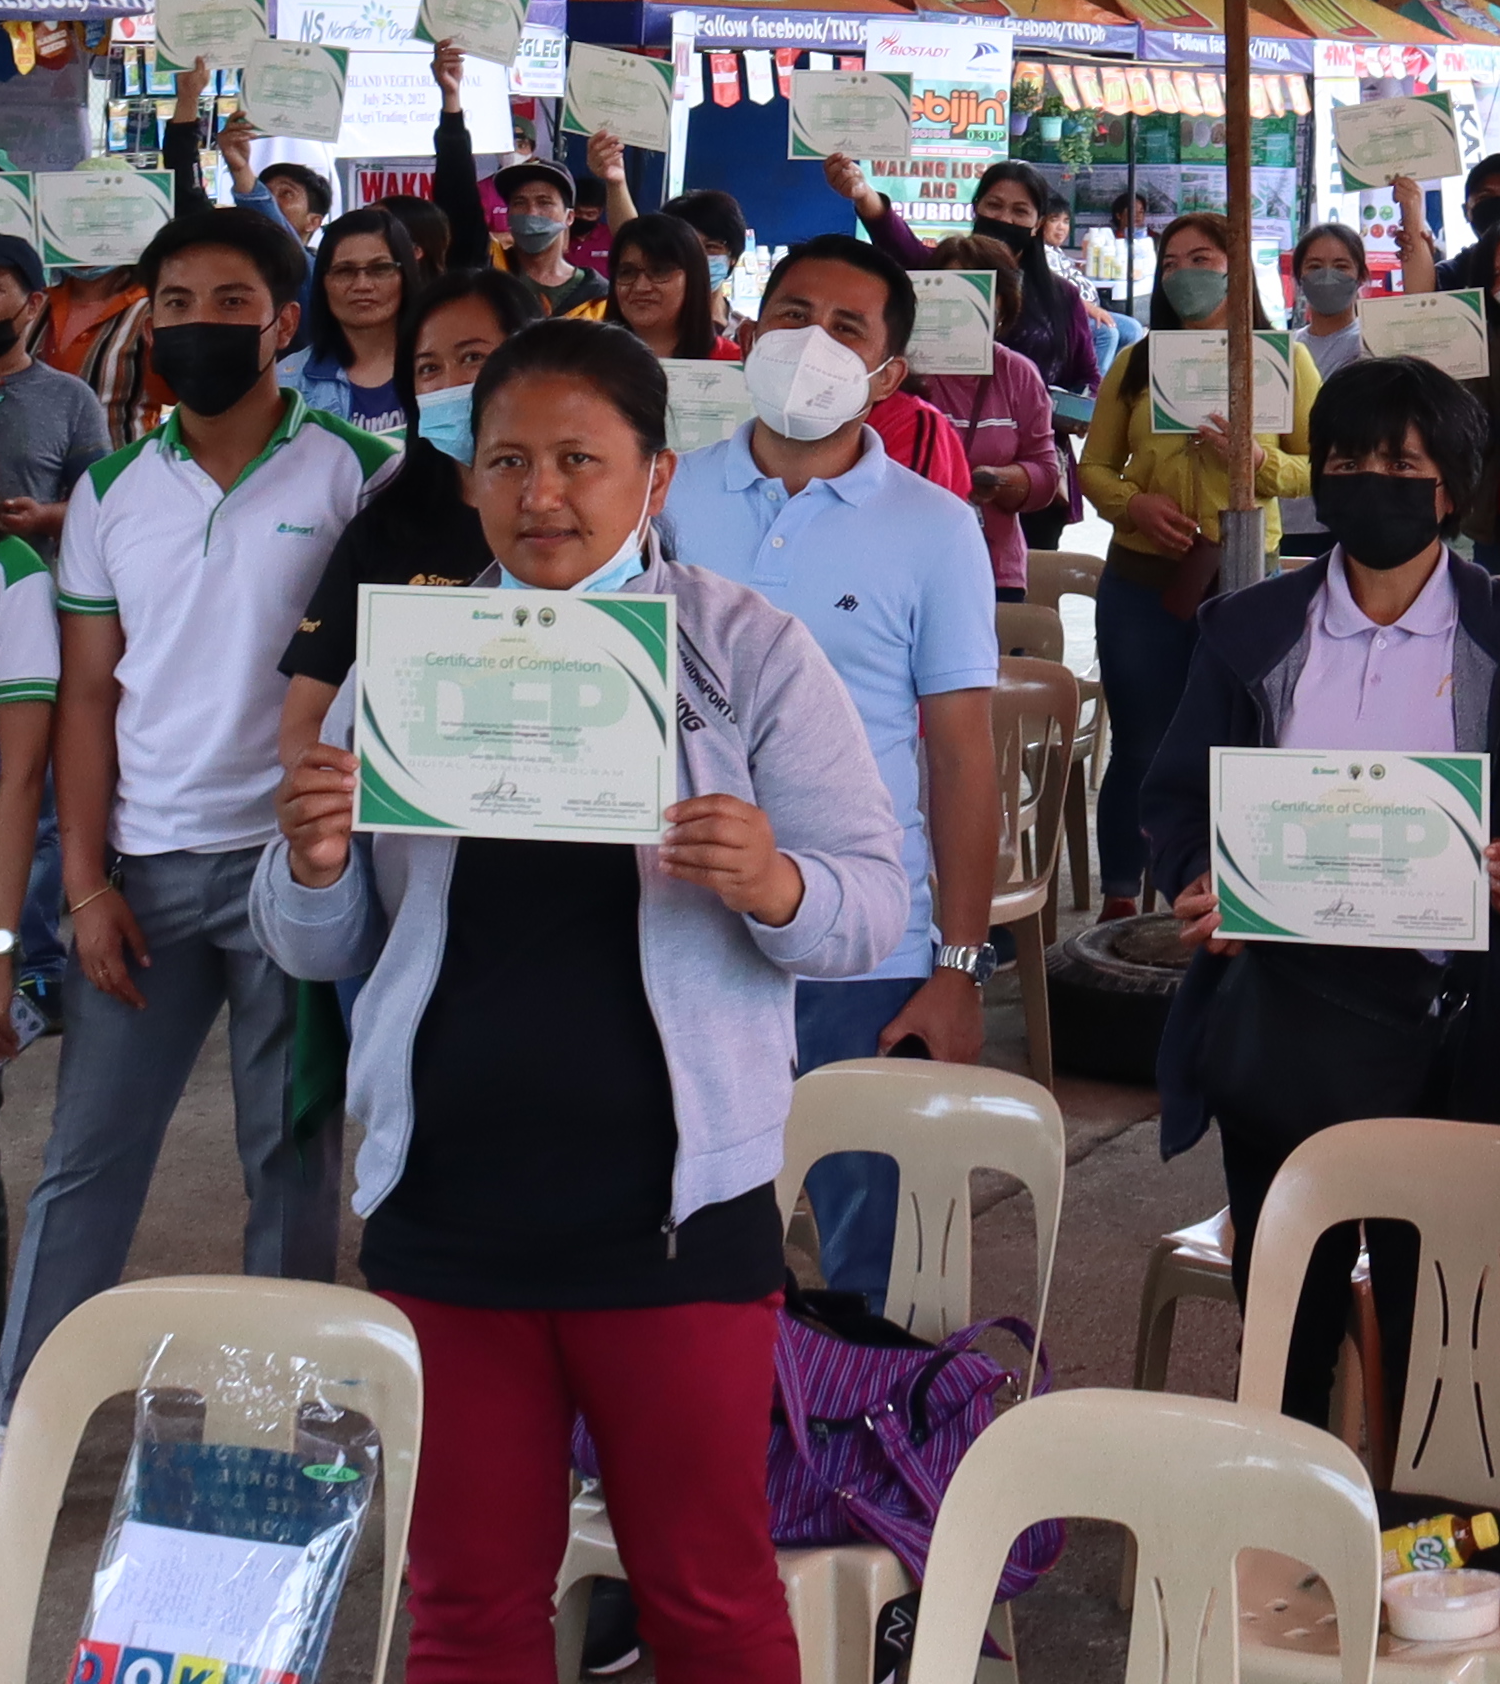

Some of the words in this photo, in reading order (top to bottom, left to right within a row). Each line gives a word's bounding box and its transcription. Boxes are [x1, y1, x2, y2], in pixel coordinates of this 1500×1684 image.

[301, 9, 325, 44] NS
[326, 21, 372, 40] Northern
[696, 15, 749, 38] Follow
[751, 16, 867, 44] facebook/TNTp
[890, 45, 951, 58] BIOSTADT
[1173, 34, 1206, 54] Follow
[362, 93, 381, 106] July
[408, 93, 427, 105] 2022
[966, 130, 986, 141] 0.3
[987, 130, 1005, 141] DP
[871, 161, 947, 178] WALANG
[918, 182, 958, 199] ANG
[425, 652, 496, 669] Certificate
[499, 654, 515, 668] of
[517, 655, 601, 674] Completion
[1271, 799, 1331, 815] Certificate
[1334, 800, 1349, 815] of
[1351, 800, 1426, 818] Completion
